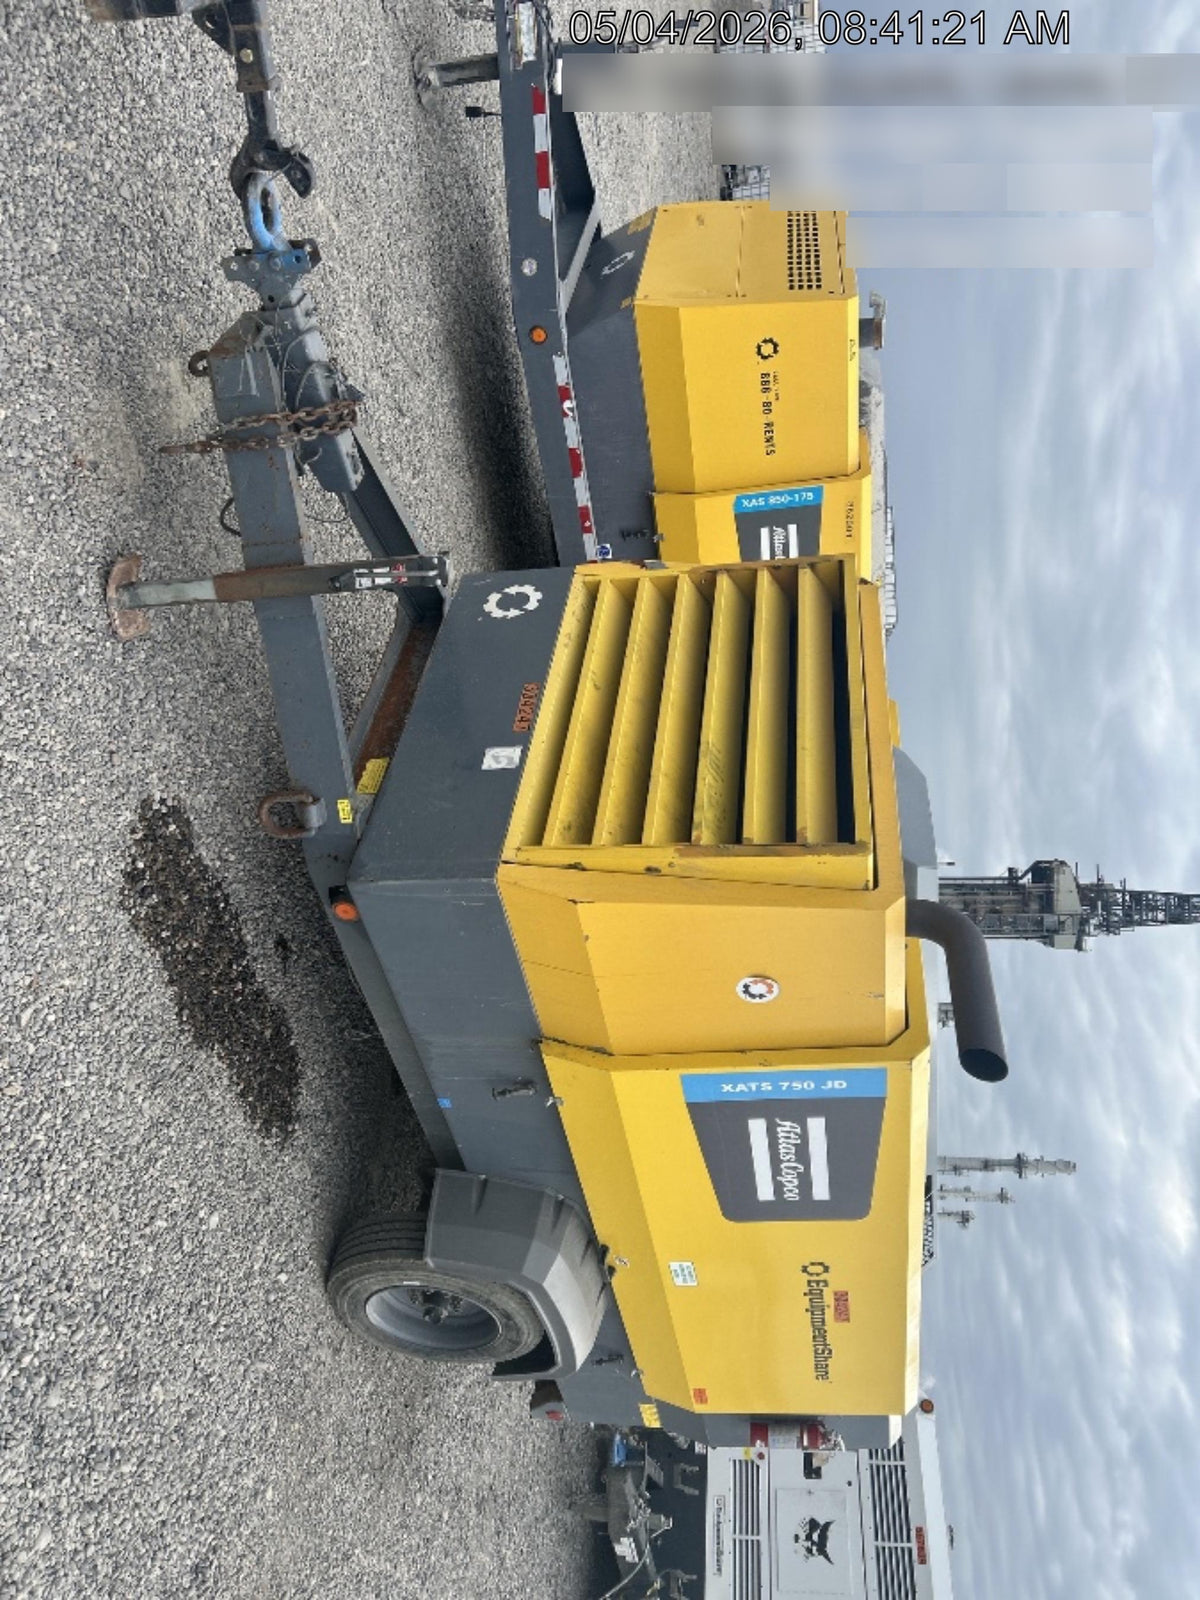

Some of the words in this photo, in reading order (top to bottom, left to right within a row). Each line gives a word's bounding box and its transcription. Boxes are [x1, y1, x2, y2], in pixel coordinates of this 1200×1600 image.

[741, 498, 766, 508] XAS
[720, 1081, 773, 1093] XATS
[778, 1080, 816, 1091] 750
[821, 1079, 848, 1090] JD
[803, 1278, 833, 1381] EquipmentShare
